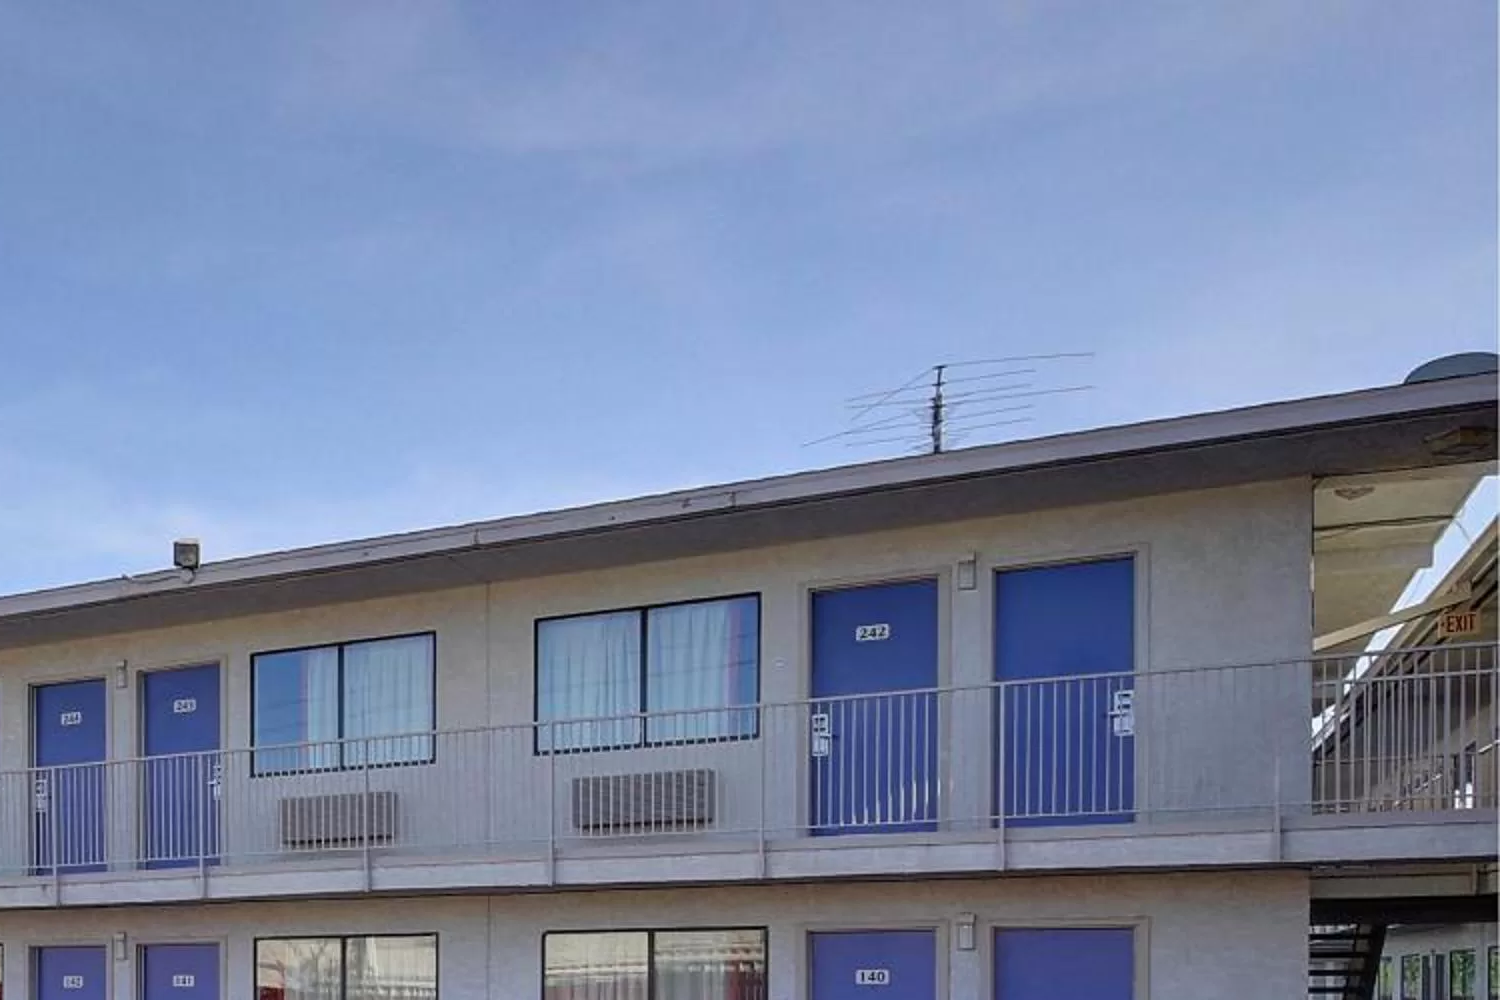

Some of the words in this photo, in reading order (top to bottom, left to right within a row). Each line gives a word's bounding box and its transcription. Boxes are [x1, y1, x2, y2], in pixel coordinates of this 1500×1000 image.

[1445, 613, 1477, 633] EXIT
[860, 625, 887, 640] 242
[860, 971, 886, 983] 140
